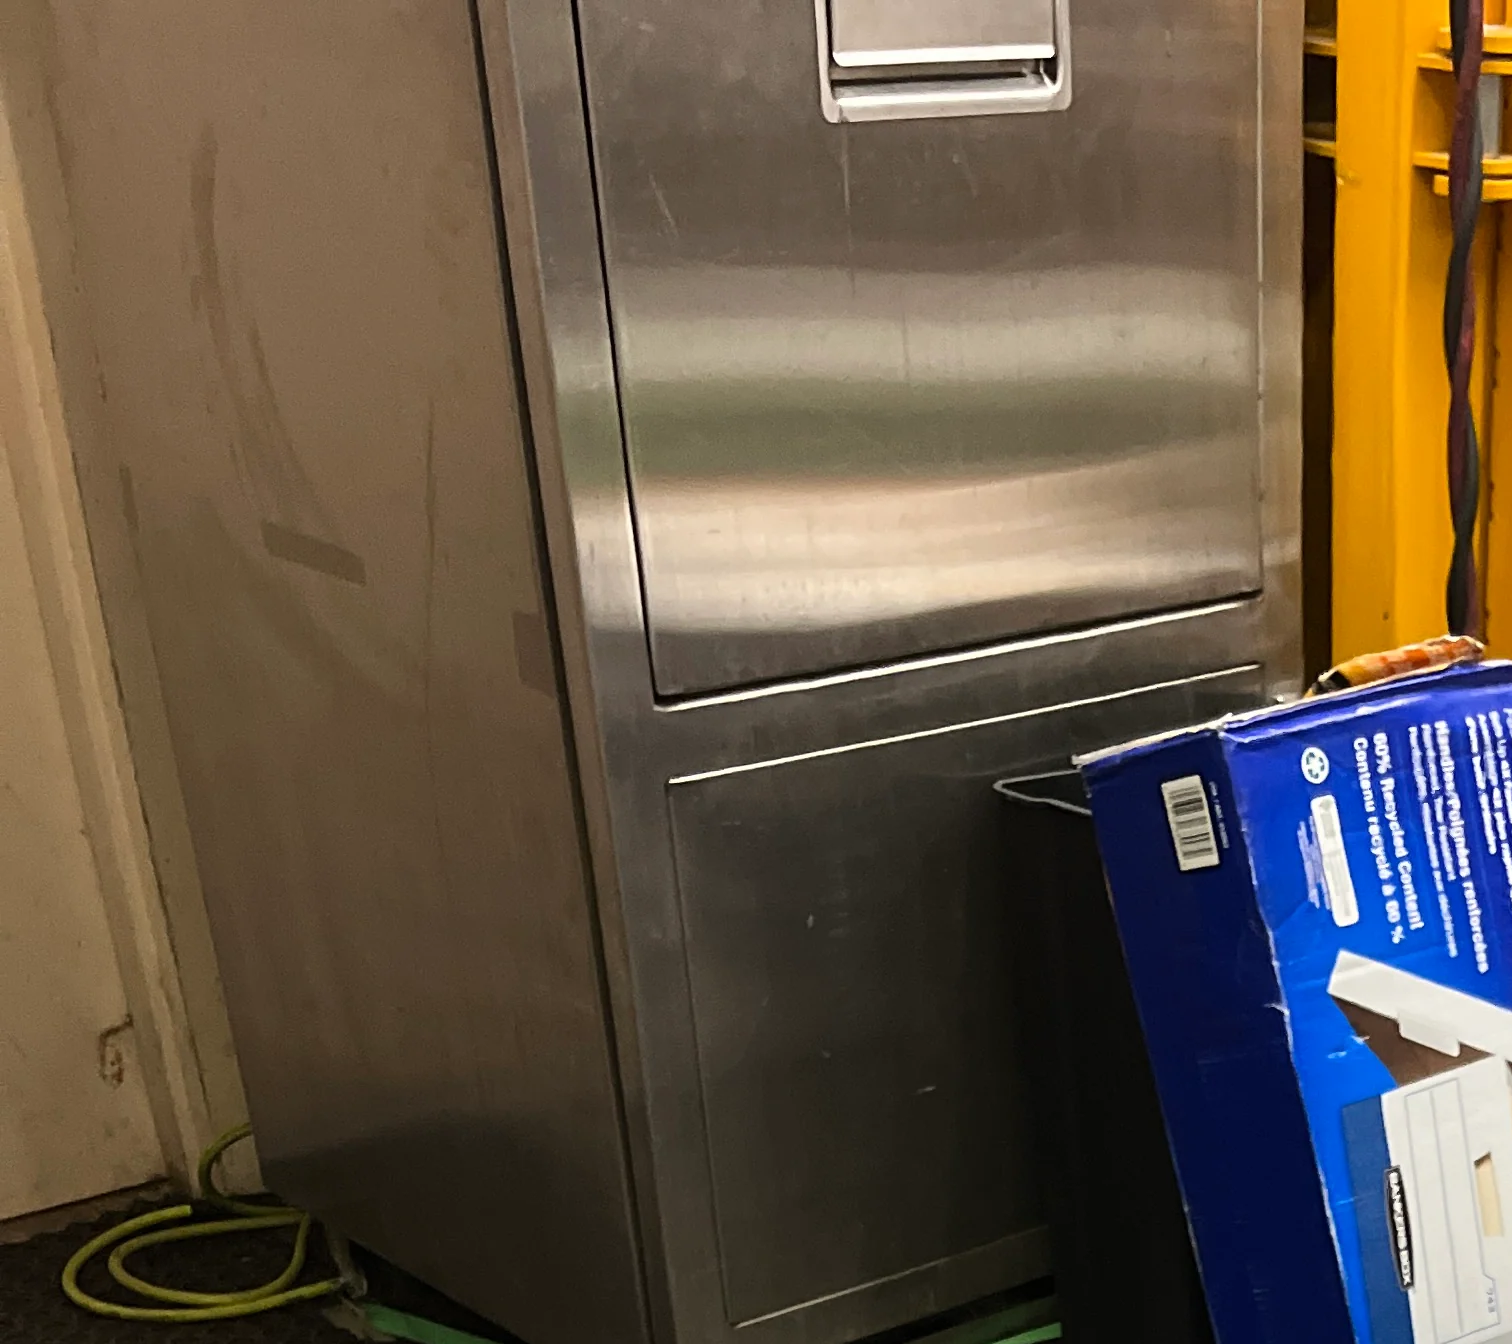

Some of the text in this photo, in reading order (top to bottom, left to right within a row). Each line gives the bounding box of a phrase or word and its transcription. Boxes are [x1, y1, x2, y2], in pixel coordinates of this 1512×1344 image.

[1354, 737, 1375, 812] Contenu
[1368, 816, 1392, 880] recyclé
[1389, 925, 1404, 944] %
[1373, 732, 1424, 930] 60% Recycled Content
[1463, 881, 1488, 973] renforcées
[1389, 1172, 1411, 1285] BANKERS BOX
